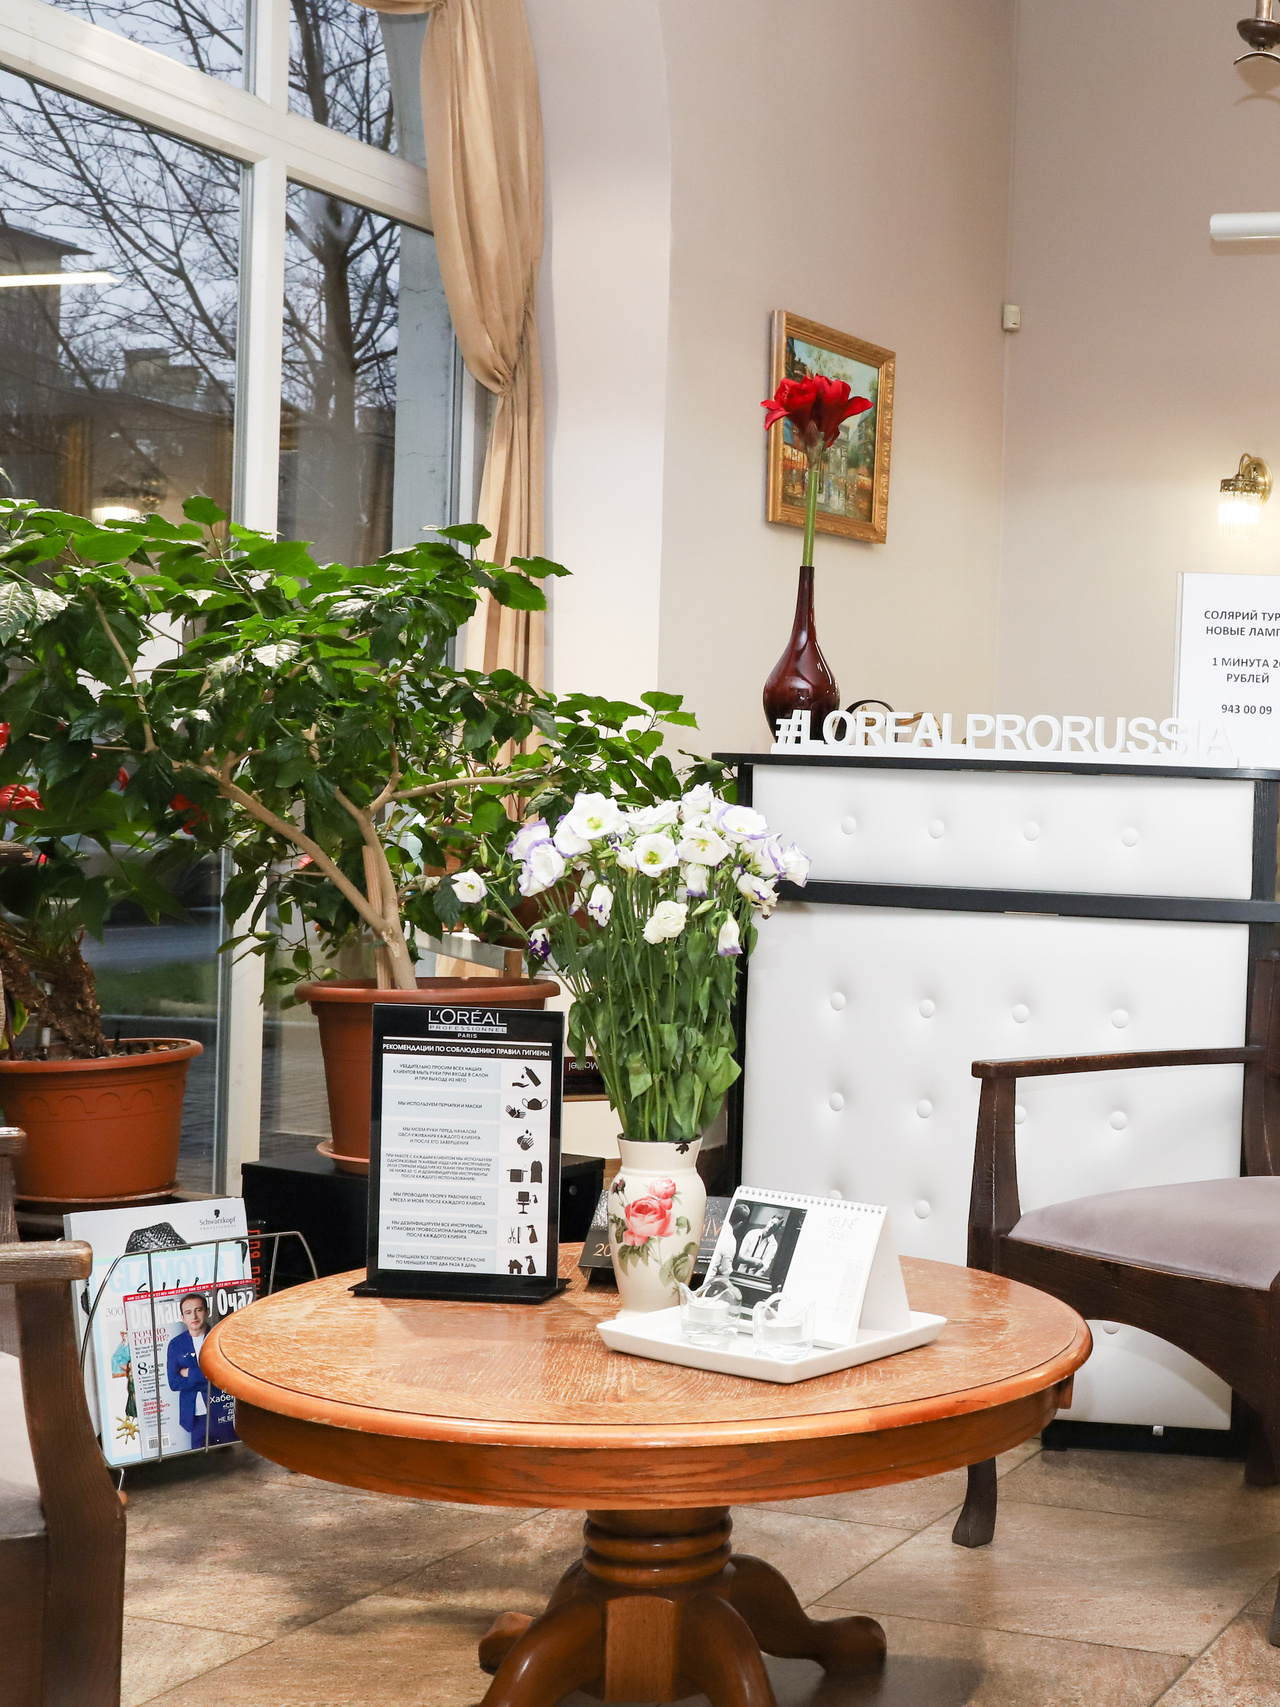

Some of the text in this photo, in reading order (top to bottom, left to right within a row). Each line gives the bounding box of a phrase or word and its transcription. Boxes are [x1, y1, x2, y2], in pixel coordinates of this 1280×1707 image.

[1204, 610, 1258, 621] СОЛЯРИЙ
[1206, 626, 1246, 636] НОВЫЕ
[1212, 657, 1217, 666] 1
[1221, 658, 1270, 668] МИНУТА
[1226, 673, 1270, 684] РУБЛЕЙ
[1221, 704, 1272, 715] 943 00 09
[775, 709, 1233, 757] #LOREALPRORUSSIA
[428, 1008, 507, 1026] L'ORÉAL
[382, 1043, 434, 1052] РЕКОМЕНДАЦИИ
[446, 1045, 496, 1054] СОБЛЮДЕНИЮ
[522, 1049, 550, 1057] ГИГИЕНЫ
[199, 1216, 236, 1225] Schwarzkopf
[828, 1230, 849, 1242] 2020
[138, 1362, 148, 1376] 8
